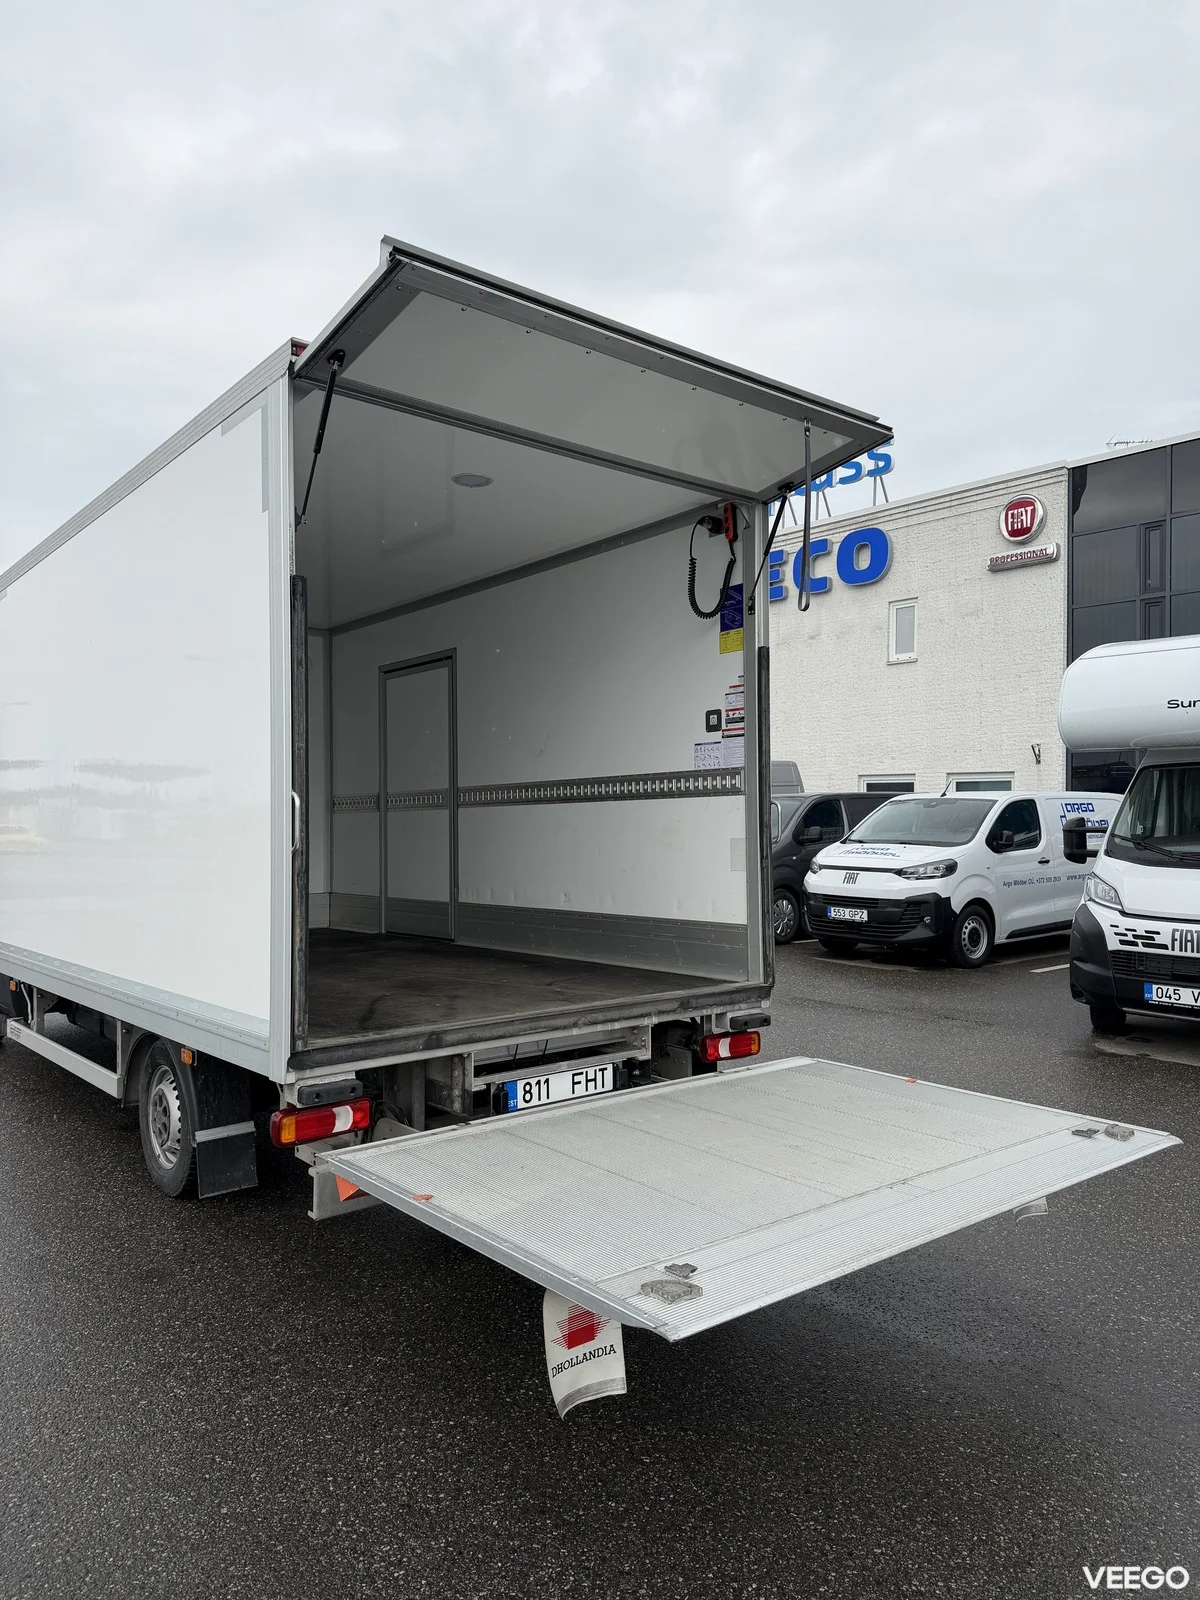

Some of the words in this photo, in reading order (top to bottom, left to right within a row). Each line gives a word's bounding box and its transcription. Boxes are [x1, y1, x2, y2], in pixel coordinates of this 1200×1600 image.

[1008, 506, 1034, 531] FIAT
[989, 548, 1049, 565] PROFESSIONAL
[843, 872, 860, 884] FIAT
[833, 908, 846, 917] 553
[848, 910, 865, 919] GPZ
[1156, 986, 1181, 1001] 045
[522, 1077, 550, 1104] 811
[571, 1067, 608, 1095] FHT
[551, 1344, 617, 1378] DHOLLANDIA
